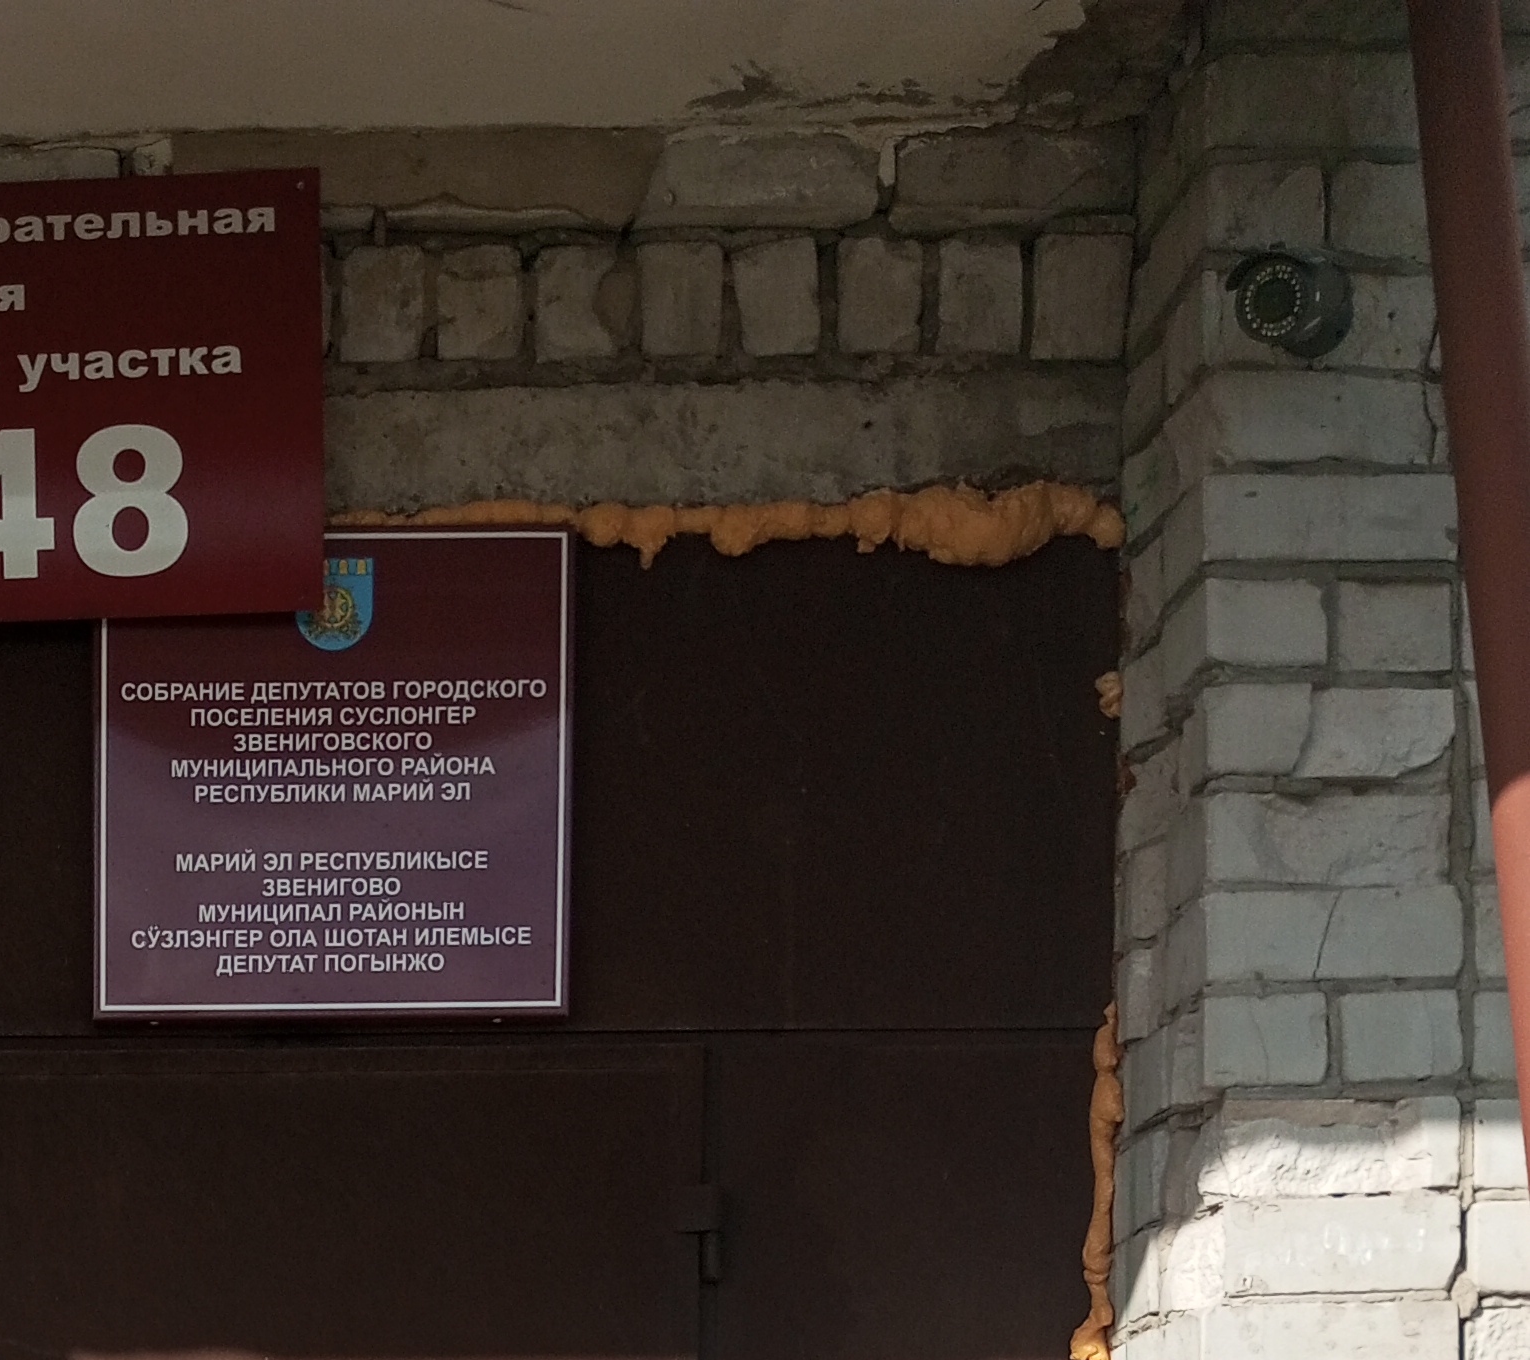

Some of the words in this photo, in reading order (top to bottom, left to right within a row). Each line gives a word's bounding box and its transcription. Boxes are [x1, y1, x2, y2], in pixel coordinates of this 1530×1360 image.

[18, 343, 242, 392] участка
[121, 682, 245, 701] СОБРАНИЕ
[251, 681, 385, 704] ДЕПУТАТОВ
[393, 680, 546, 702] ГОРОДСКОГО
[191, 708, 332, 726] ПОСЕЛЕНИЯ
[340, 706, 476, 725] СУСЛОНГЕР
[234, 732, 431, 752] ЗВЕНИГОВСКОГО
[171, 758, 394, 780] МУНИЦИПАЛЬНОГО
[401, 753, 495, 775] РАЙОНА
[195, 784, 345, 803] РЕСПУБЛИКИ
[353, 778, 433, 801] МАРИЙ
[441, 783, 470, 800] ЭЛ
[176, 849, 256, 871] МАРИЙ
[263, 853, 292, 871] ЭЛ
[301, 851, 488, 871] РЕСПУБЛИКЫСЕ
[262, 877, 400, 896] ЗВЕНИГОВО
[199, 903, 341, 924] МУНИЦИПАЛ
[349, 899, 464, 921] РАЙОНЫН
[271, 929, 317, 947] ОЛА
[325, 928, 407, 946] ШОТАН
[415, 927, 531, 946] ИЛЕМЫСЕ
[217, 954, 317, 975] ДЕПУТАТ
[325, 953, 444, 972] ПОГЫНЖО
